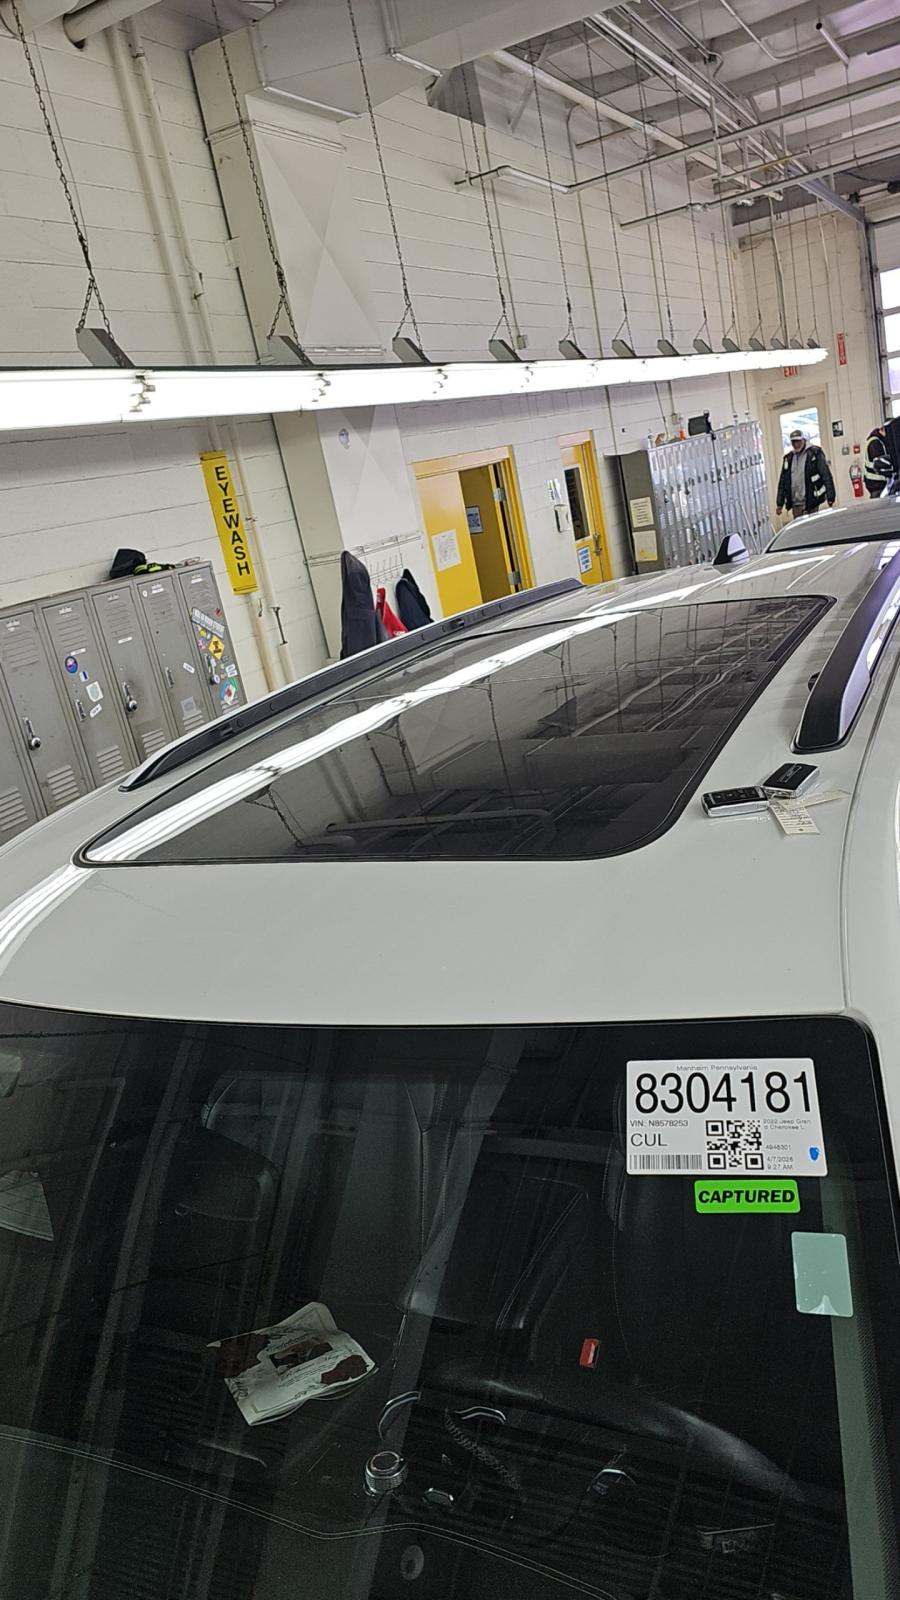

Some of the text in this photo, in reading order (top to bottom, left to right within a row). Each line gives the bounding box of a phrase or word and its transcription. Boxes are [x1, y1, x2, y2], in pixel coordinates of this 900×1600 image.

[214, 465, 251, 576] EYEWASH
[635, 1071, 811, 1114] 8304181
[630, 1133, 667, 1147] CUL
[698, 1190, 796, 1203] CAPTURED
